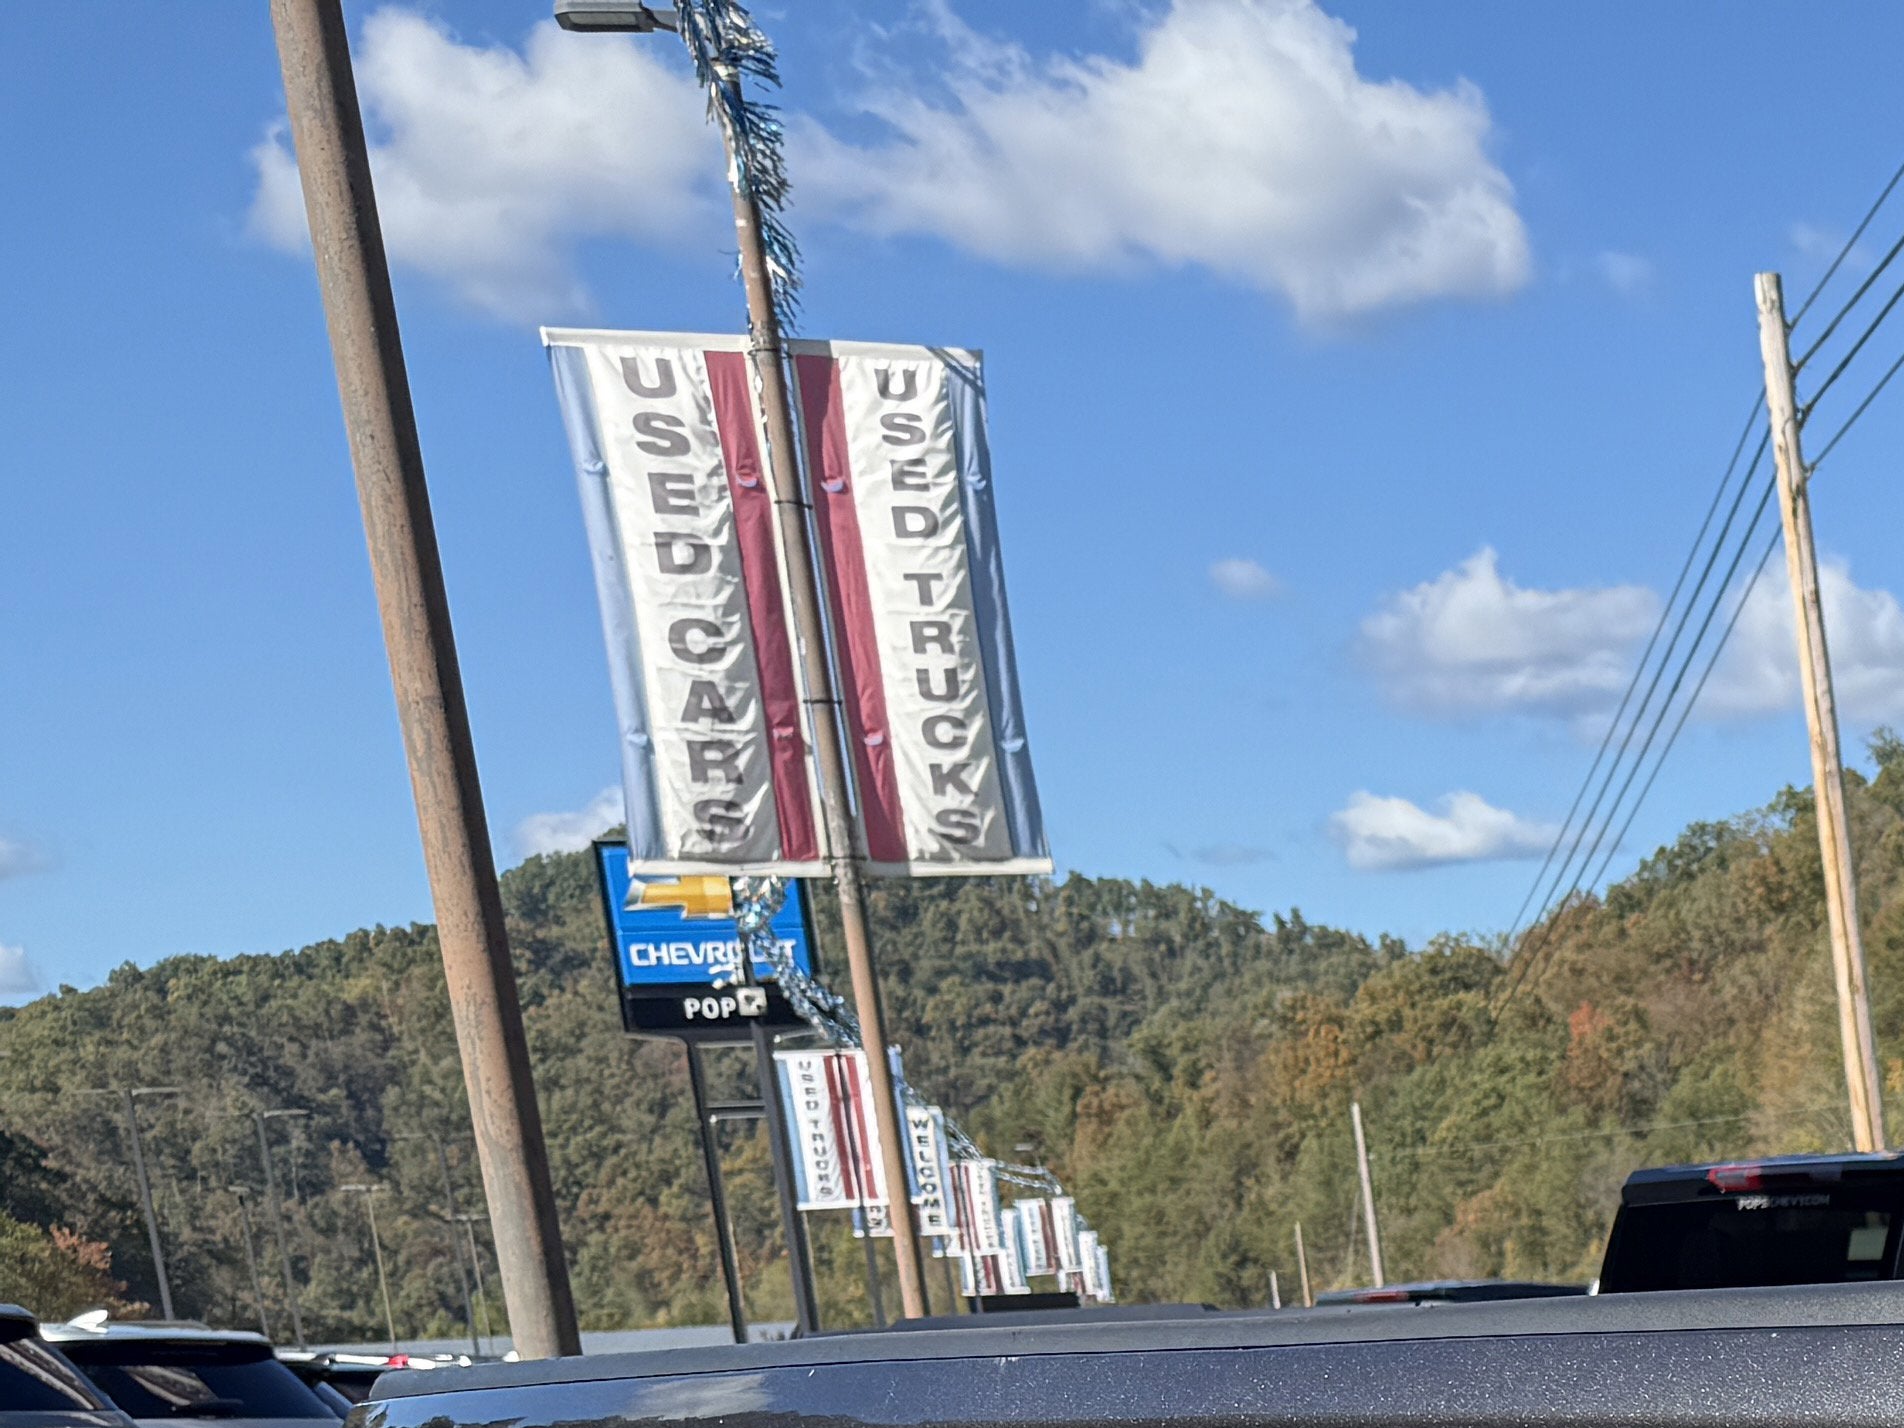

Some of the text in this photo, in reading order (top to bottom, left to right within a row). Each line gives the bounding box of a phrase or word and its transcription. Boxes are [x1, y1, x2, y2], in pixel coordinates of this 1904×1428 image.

[619, 356, 751, 845] USED CARS
[874, 368, 982, 846] USED TRUCKS
[684, 996, 737, 1020] POP
[912, 1119, 942, 1226] WELCOME
